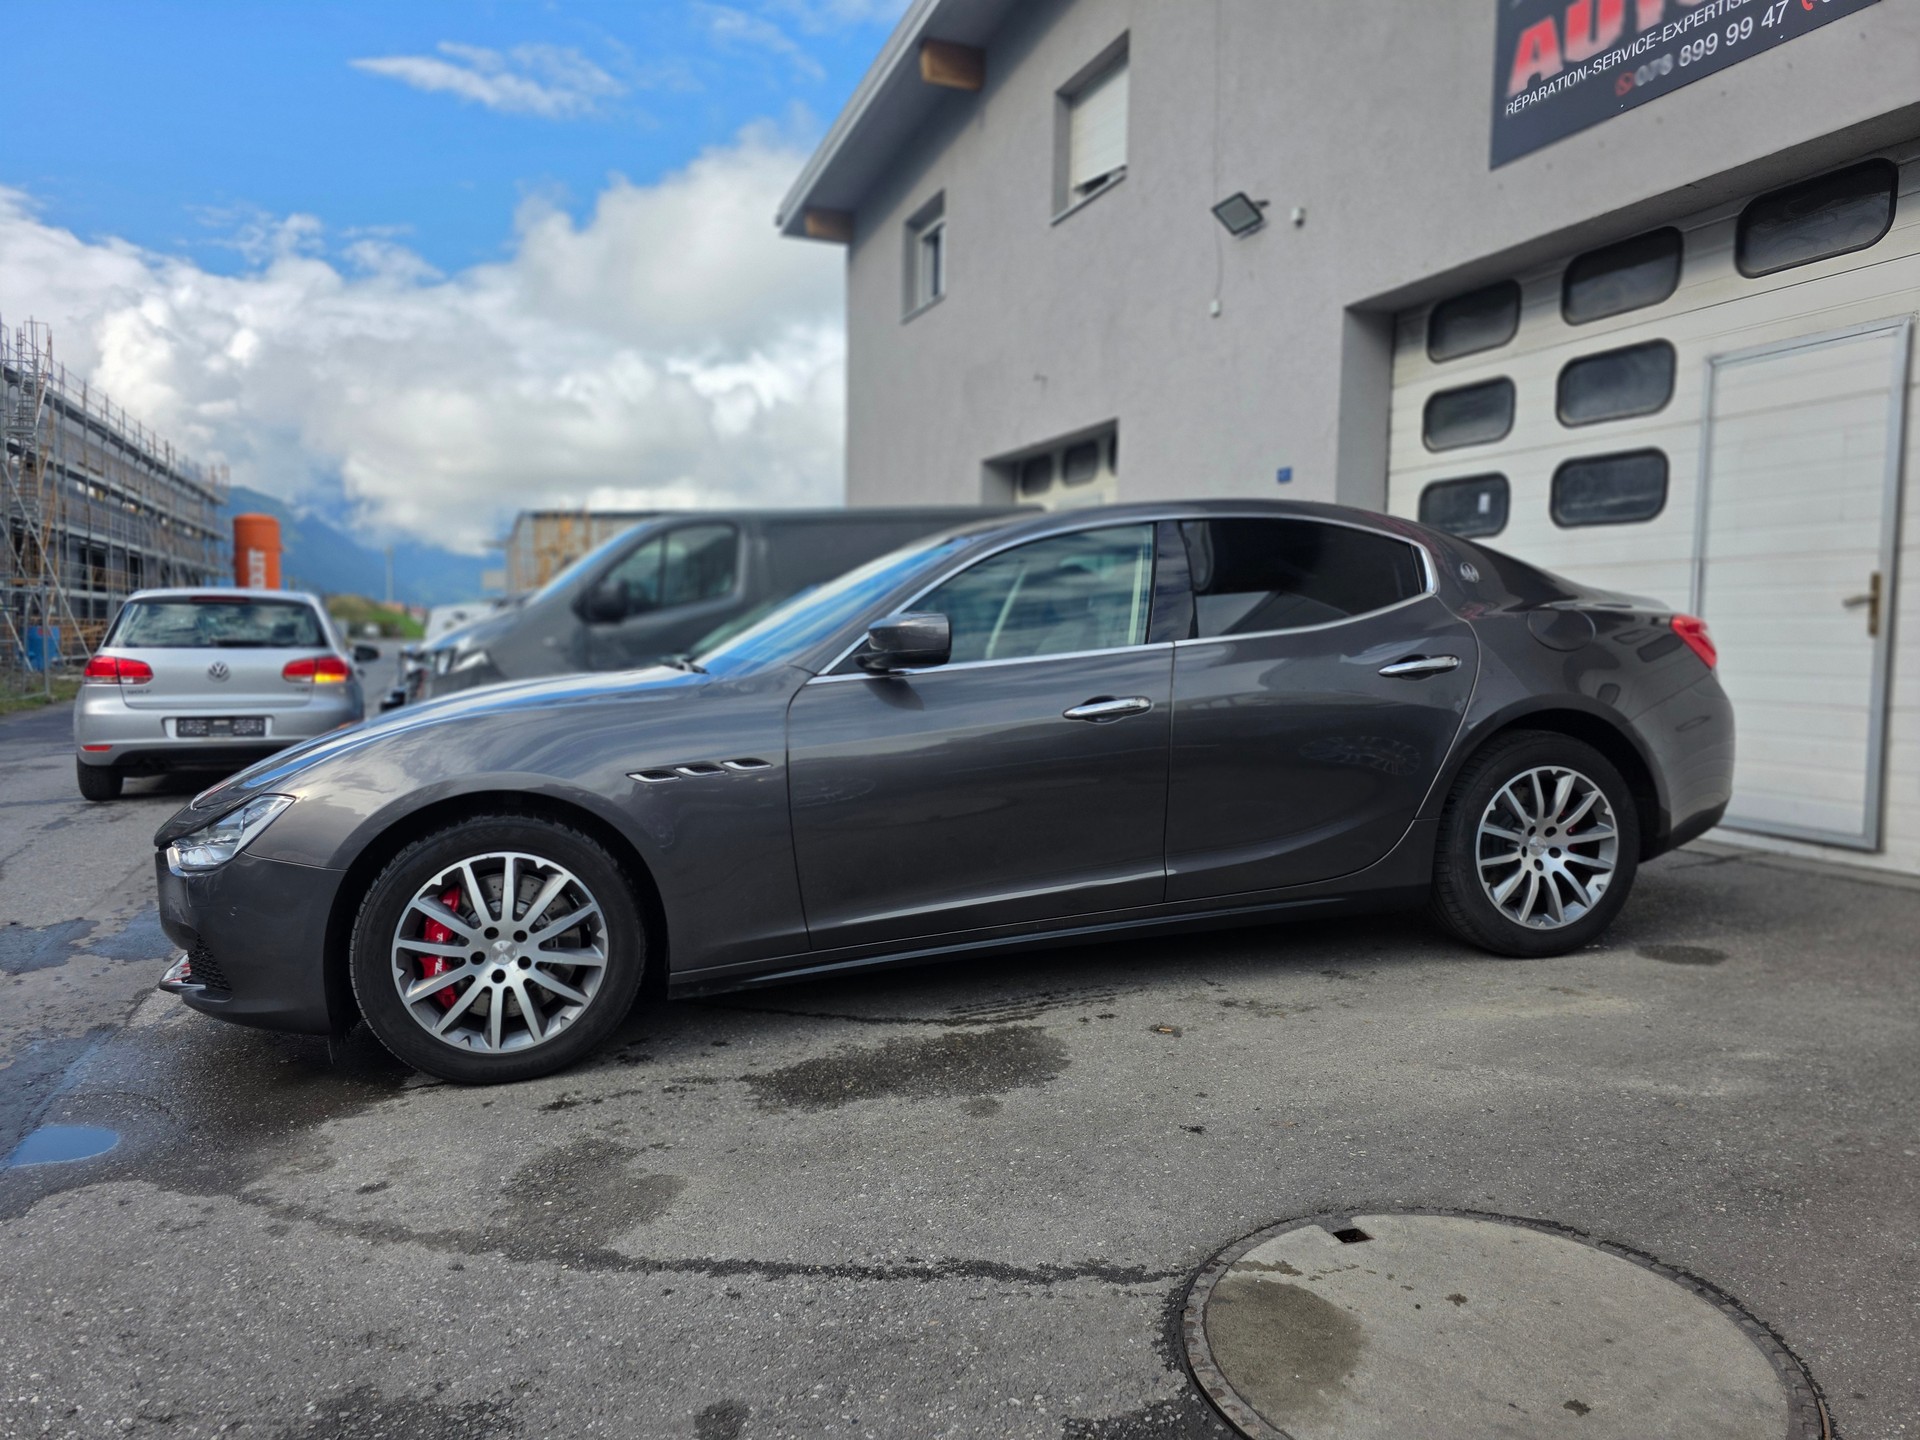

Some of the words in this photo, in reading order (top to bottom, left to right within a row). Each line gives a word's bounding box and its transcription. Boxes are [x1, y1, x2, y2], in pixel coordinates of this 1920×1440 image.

[1508, 0, 1703, 97] AU
[1678, 32, 1719, 67] 899
[1725, 16, 1753, 46] 99
[1761, 0, 1789, 28] 47
